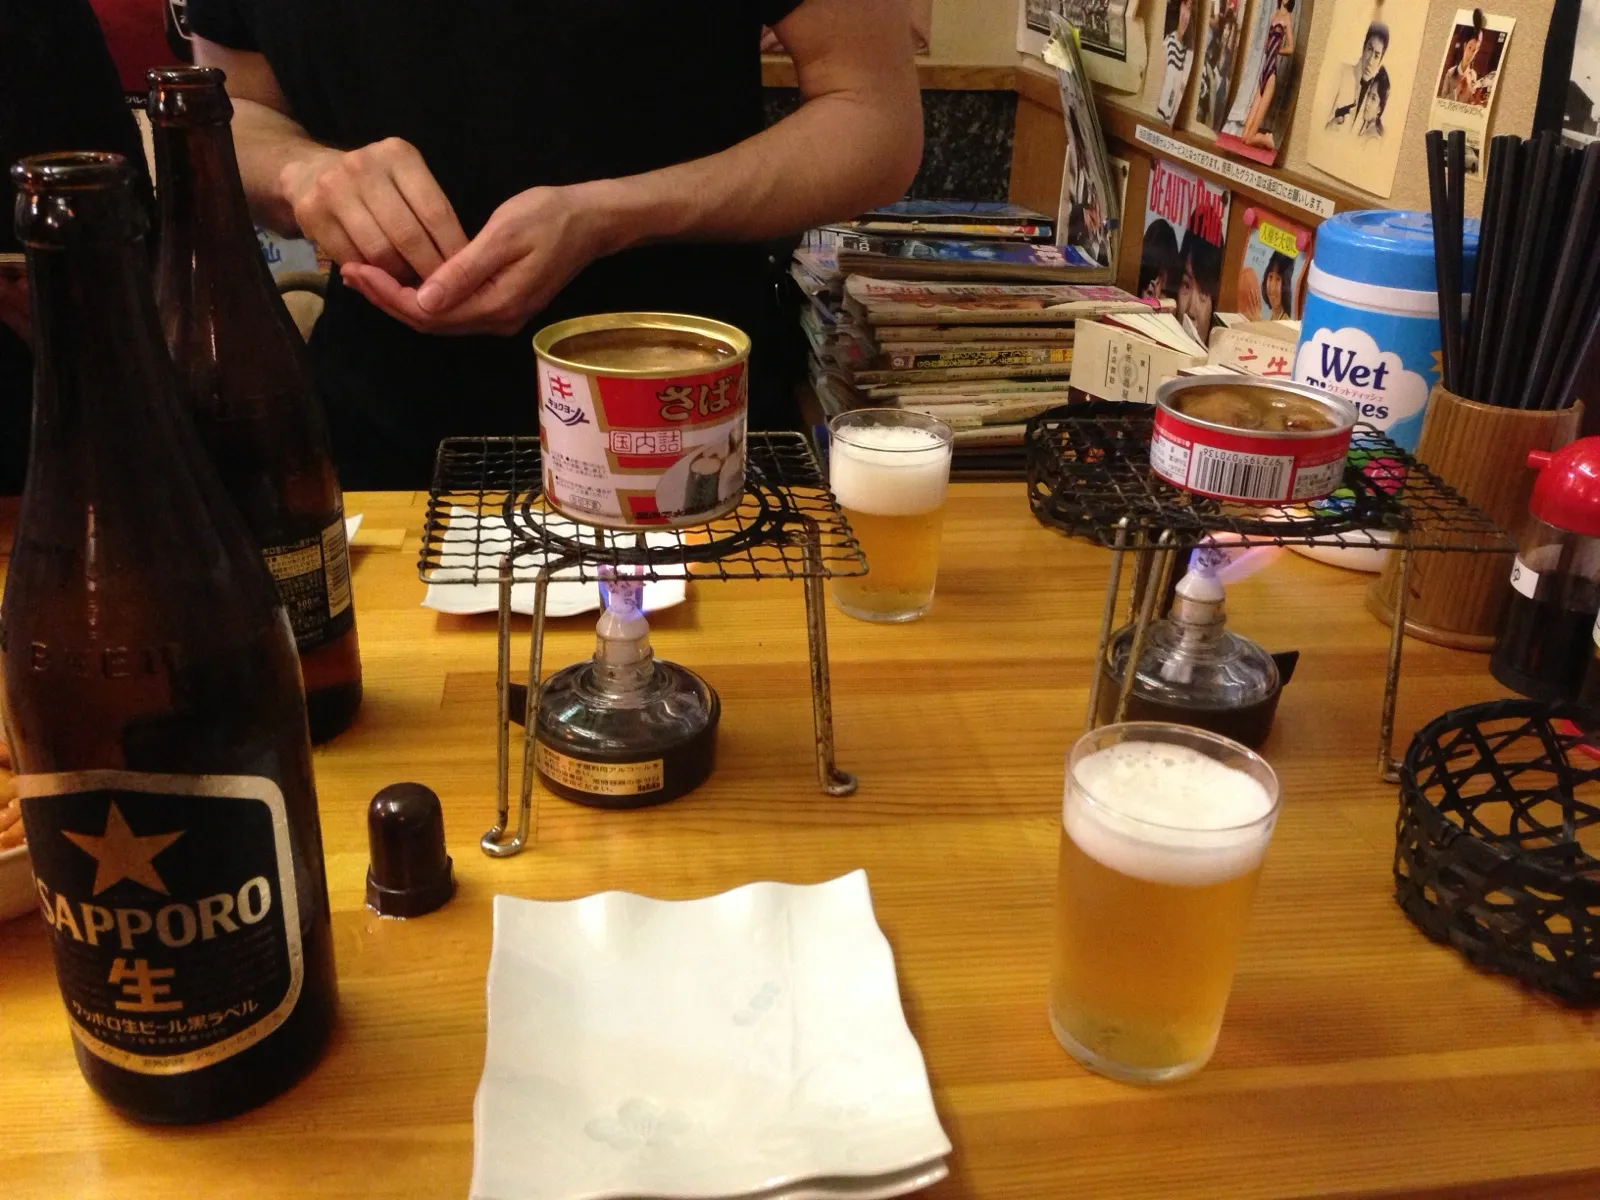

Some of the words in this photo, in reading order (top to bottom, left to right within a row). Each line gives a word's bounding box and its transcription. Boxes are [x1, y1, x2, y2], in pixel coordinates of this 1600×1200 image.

[1321, 343, 1389, 390] Wet
[613, 431, 679, 453] 国内詰
[34, 875, 272, 950] SAPPORO
[107, 957, 184, 1013] 生
